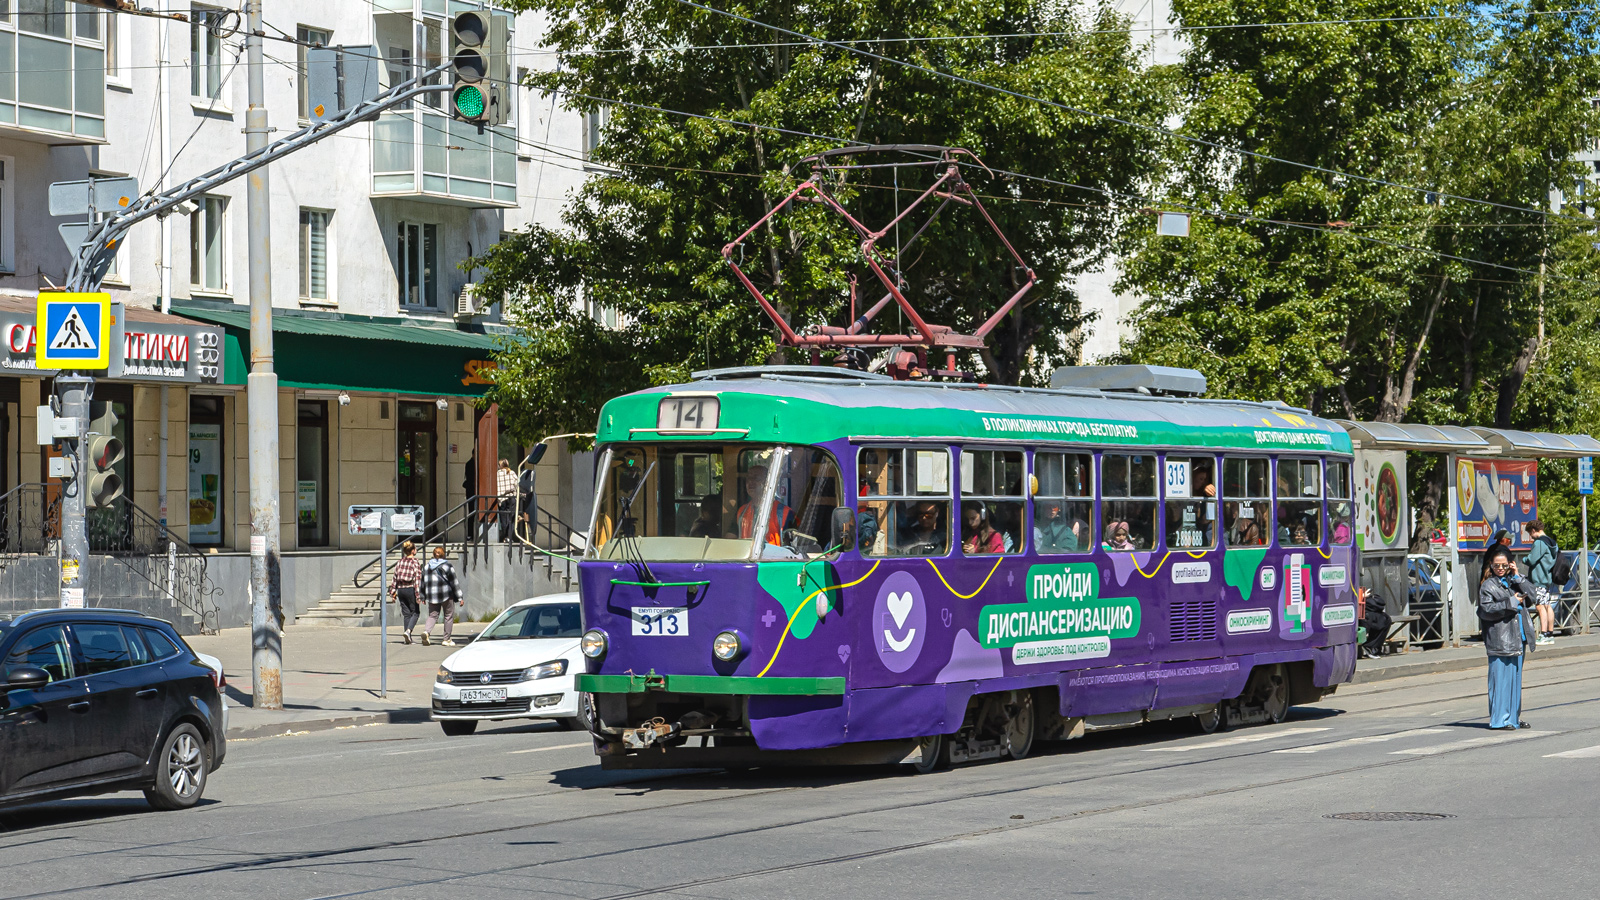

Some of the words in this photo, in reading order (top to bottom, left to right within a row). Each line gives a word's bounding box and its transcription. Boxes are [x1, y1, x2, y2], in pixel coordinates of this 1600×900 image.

[125, 332, 189, 362] ПТИКИ
[672, 400, 704, 429] 14
[982, 417, 992, 431] В
[990, 417, 1060, 434] ПОЛИКЛИНИКАХ
[1055, 420, 1092, 438] ГОРОДА
[1089, 422, 1139, 438] БЕСПЛАТНО!
[1253, 430, 1289, 445] ДОСТУПНО
[1286, 432, 1307, 446] ДАЖЕ
[1167, 463, 1185, 486] 313
[1033, 567, 1092, 602] ПРОЙДИ
[640, 614, 679, 635] 313
[986, 604, 1133, 645] ДИСПАНСЕРИЗАЦИЮ
[1015, 647, 1036, 661] ДЕРЖИ
[1036, 645, 1065, 659] ЗДОРОВЬЕ
[1065, 644, 1077, 655] ПОД
[1076, 641, 1108, 654] КОНТРОЛЕМ
